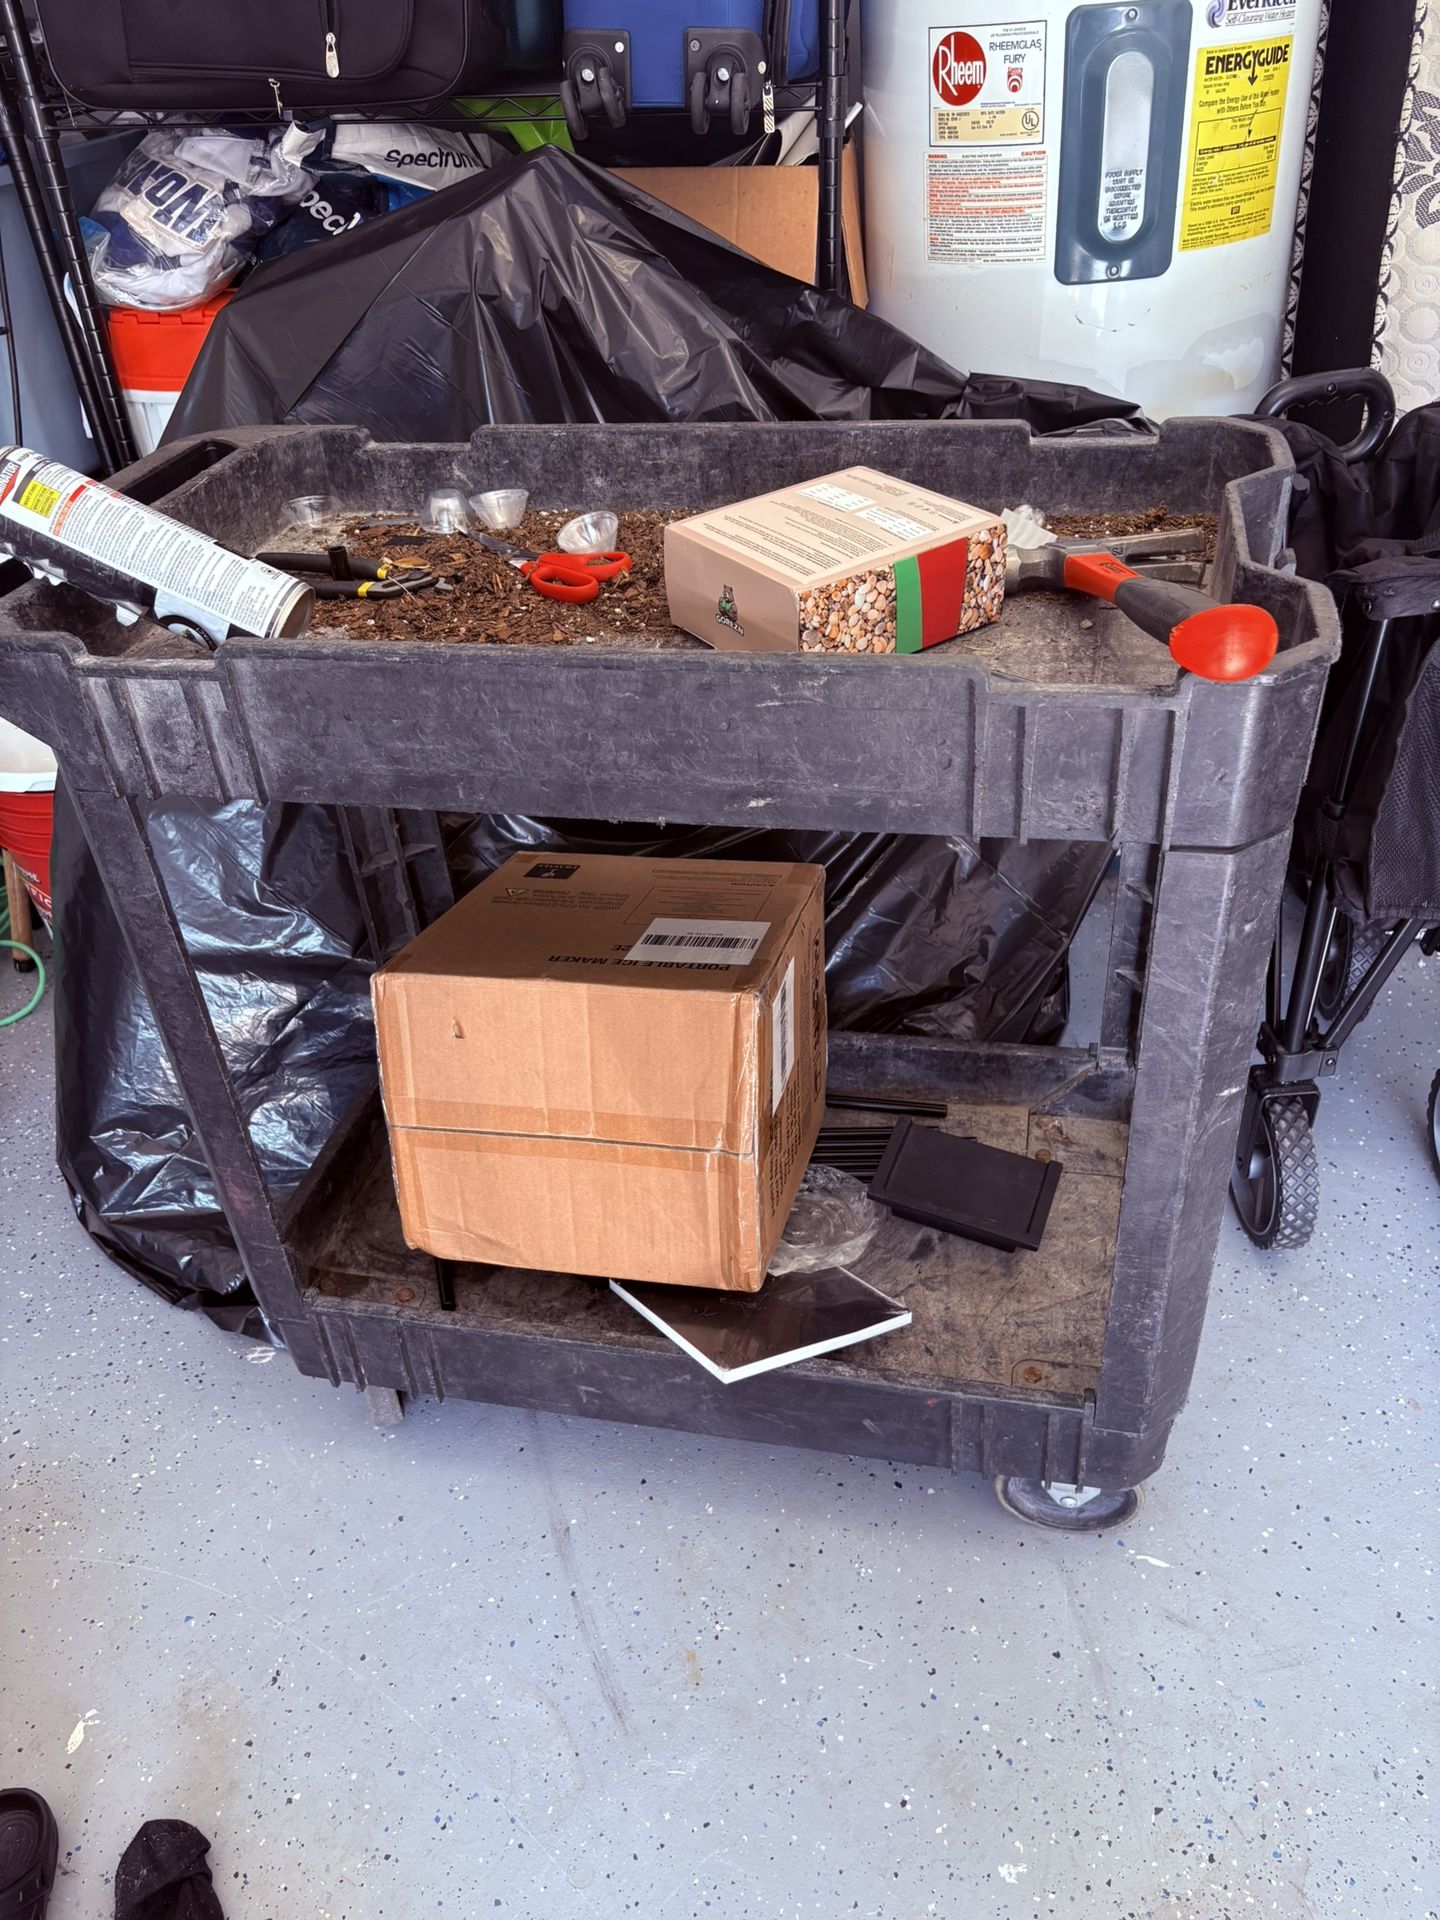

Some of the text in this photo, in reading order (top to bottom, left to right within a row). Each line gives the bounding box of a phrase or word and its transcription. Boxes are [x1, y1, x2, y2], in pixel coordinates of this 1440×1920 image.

[989, 39, 1041, 51] RHEEMGLAS
[939, 35, 984, 96] Rheem
[1003, 54, 1026, 64] FURY
[1205, 44, 1290, 76] ENERGYGUIDE
[384, 147, 481, 169] Spectrum
[547, 954, 732, 971] PORTABLE ICE MAKER
